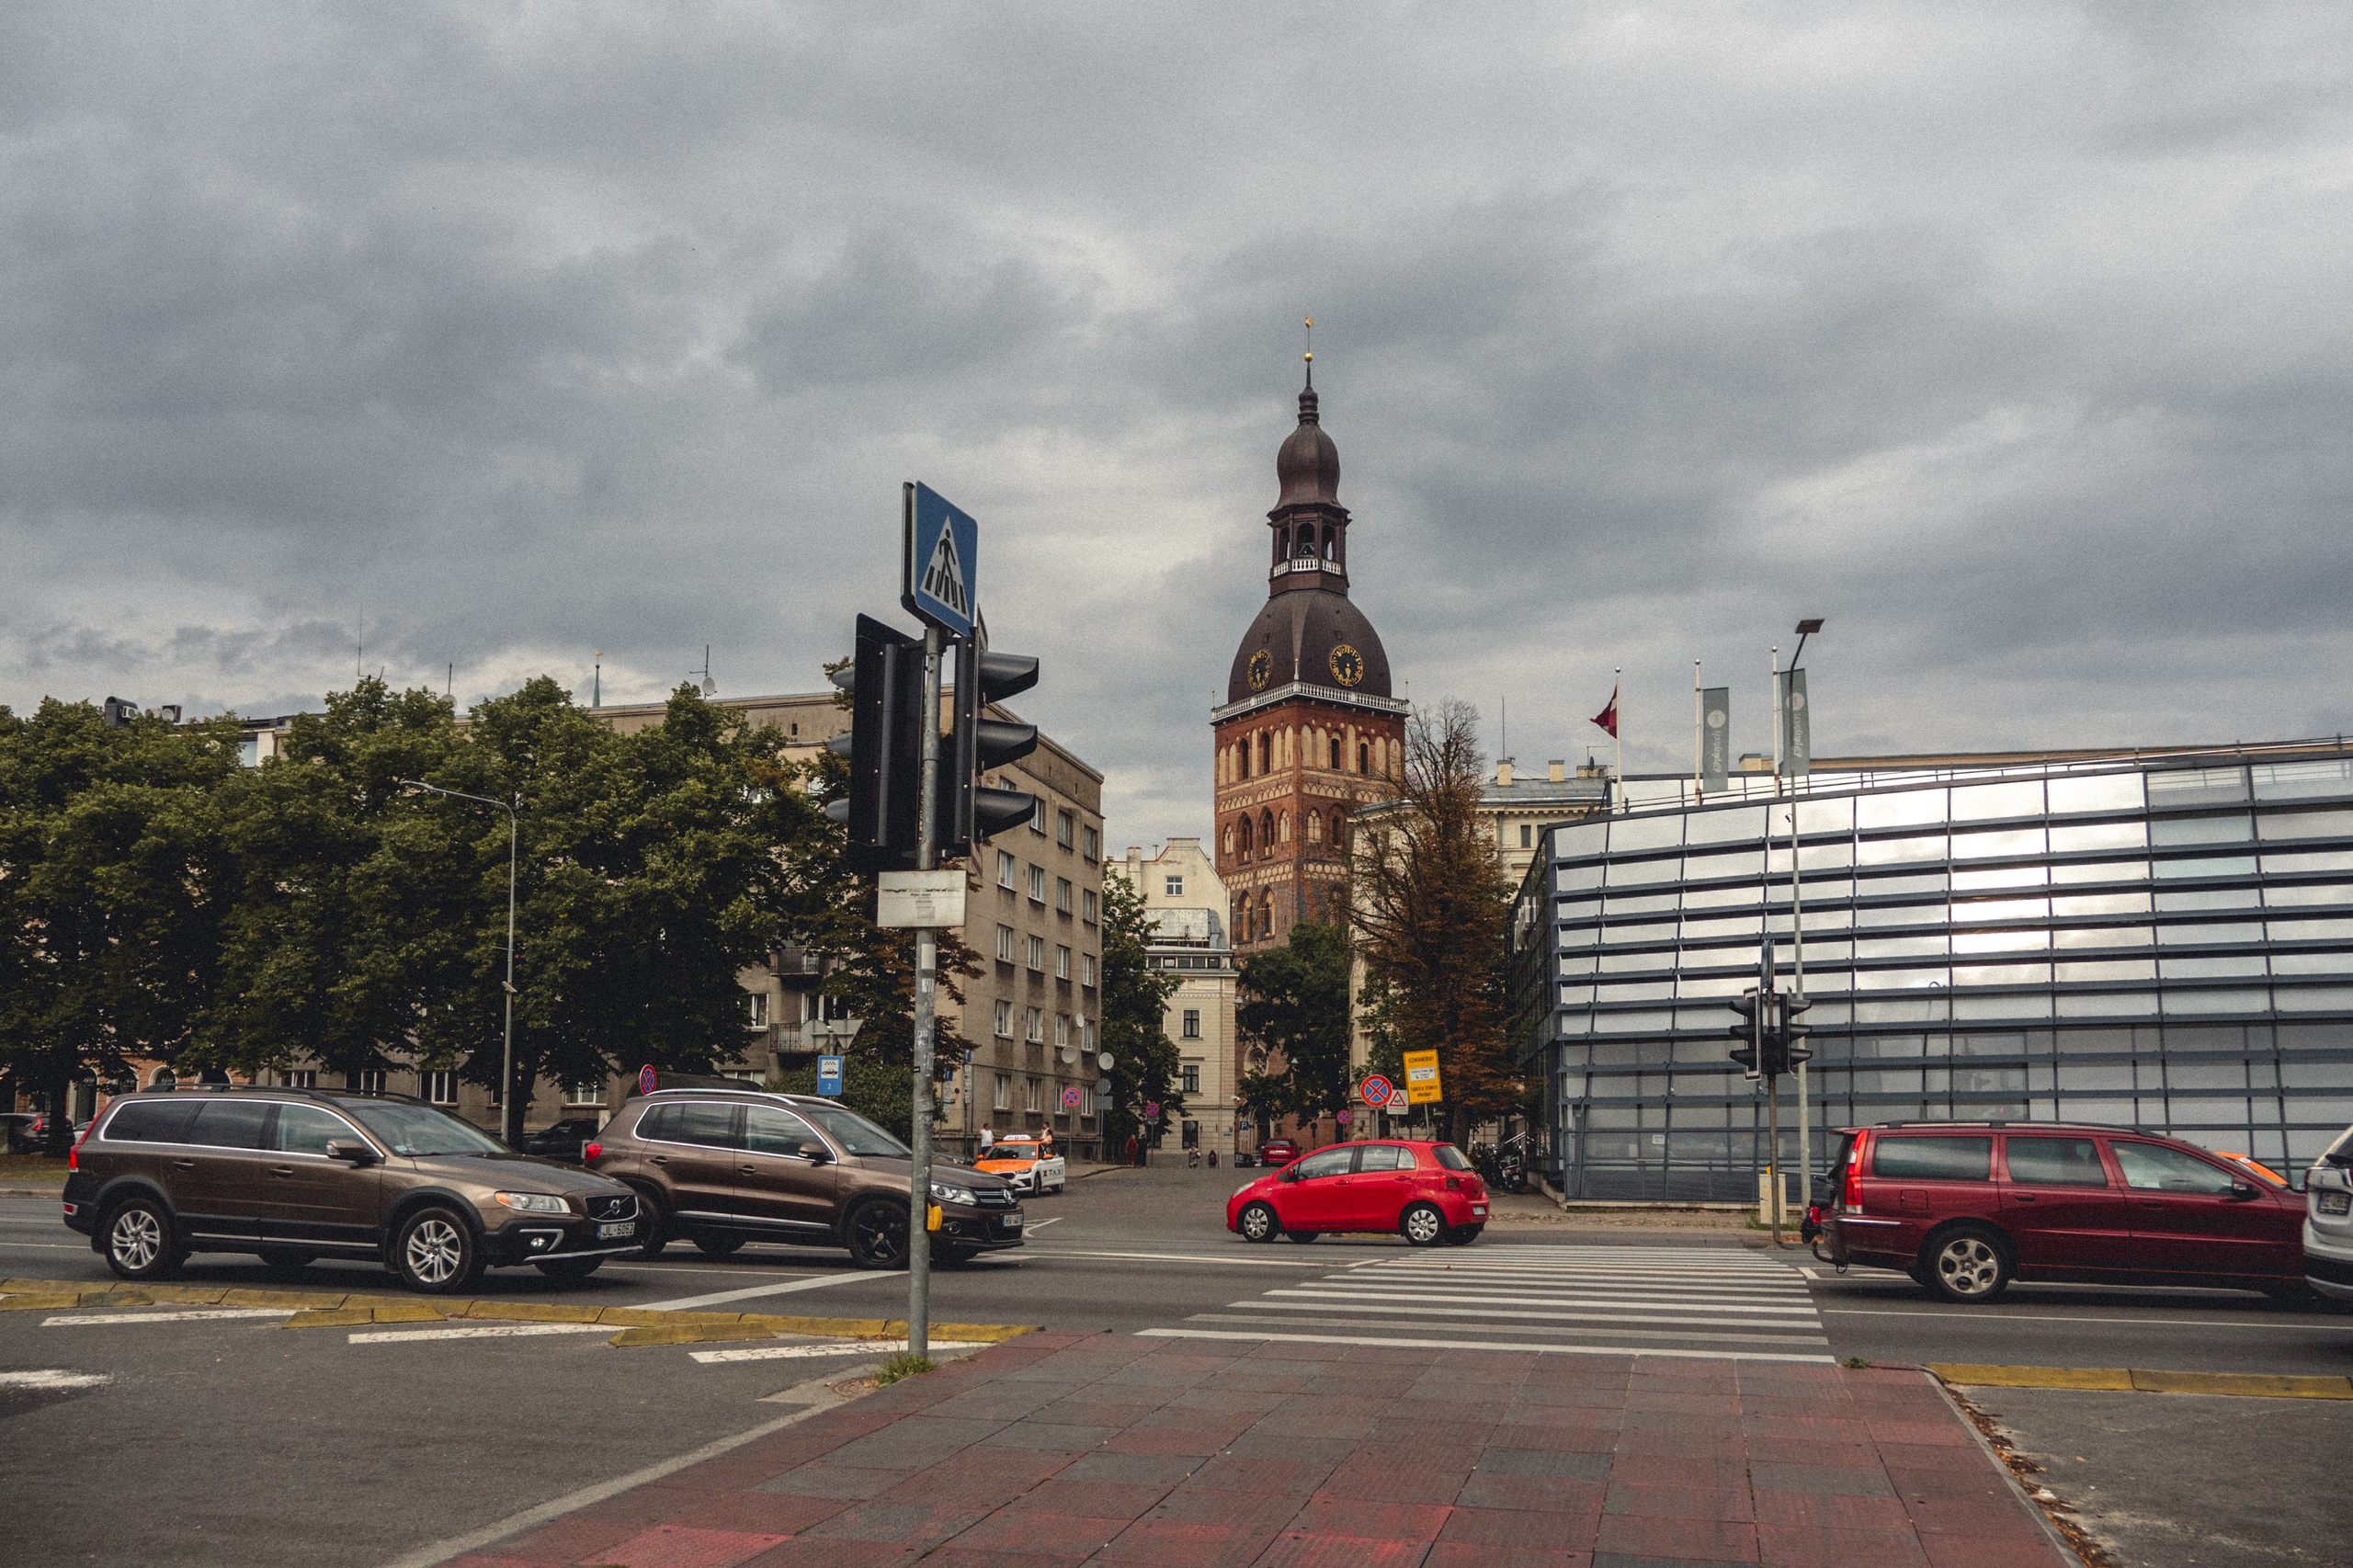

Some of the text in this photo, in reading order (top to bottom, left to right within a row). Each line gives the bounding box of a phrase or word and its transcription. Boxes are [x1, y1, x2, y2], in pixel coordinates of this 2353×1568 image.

[1711, 730, 1722, 763] playtech
[1049, 1168, 1064, 1176] TAXI
[602, 1223, 634, 1236] JL-6062
